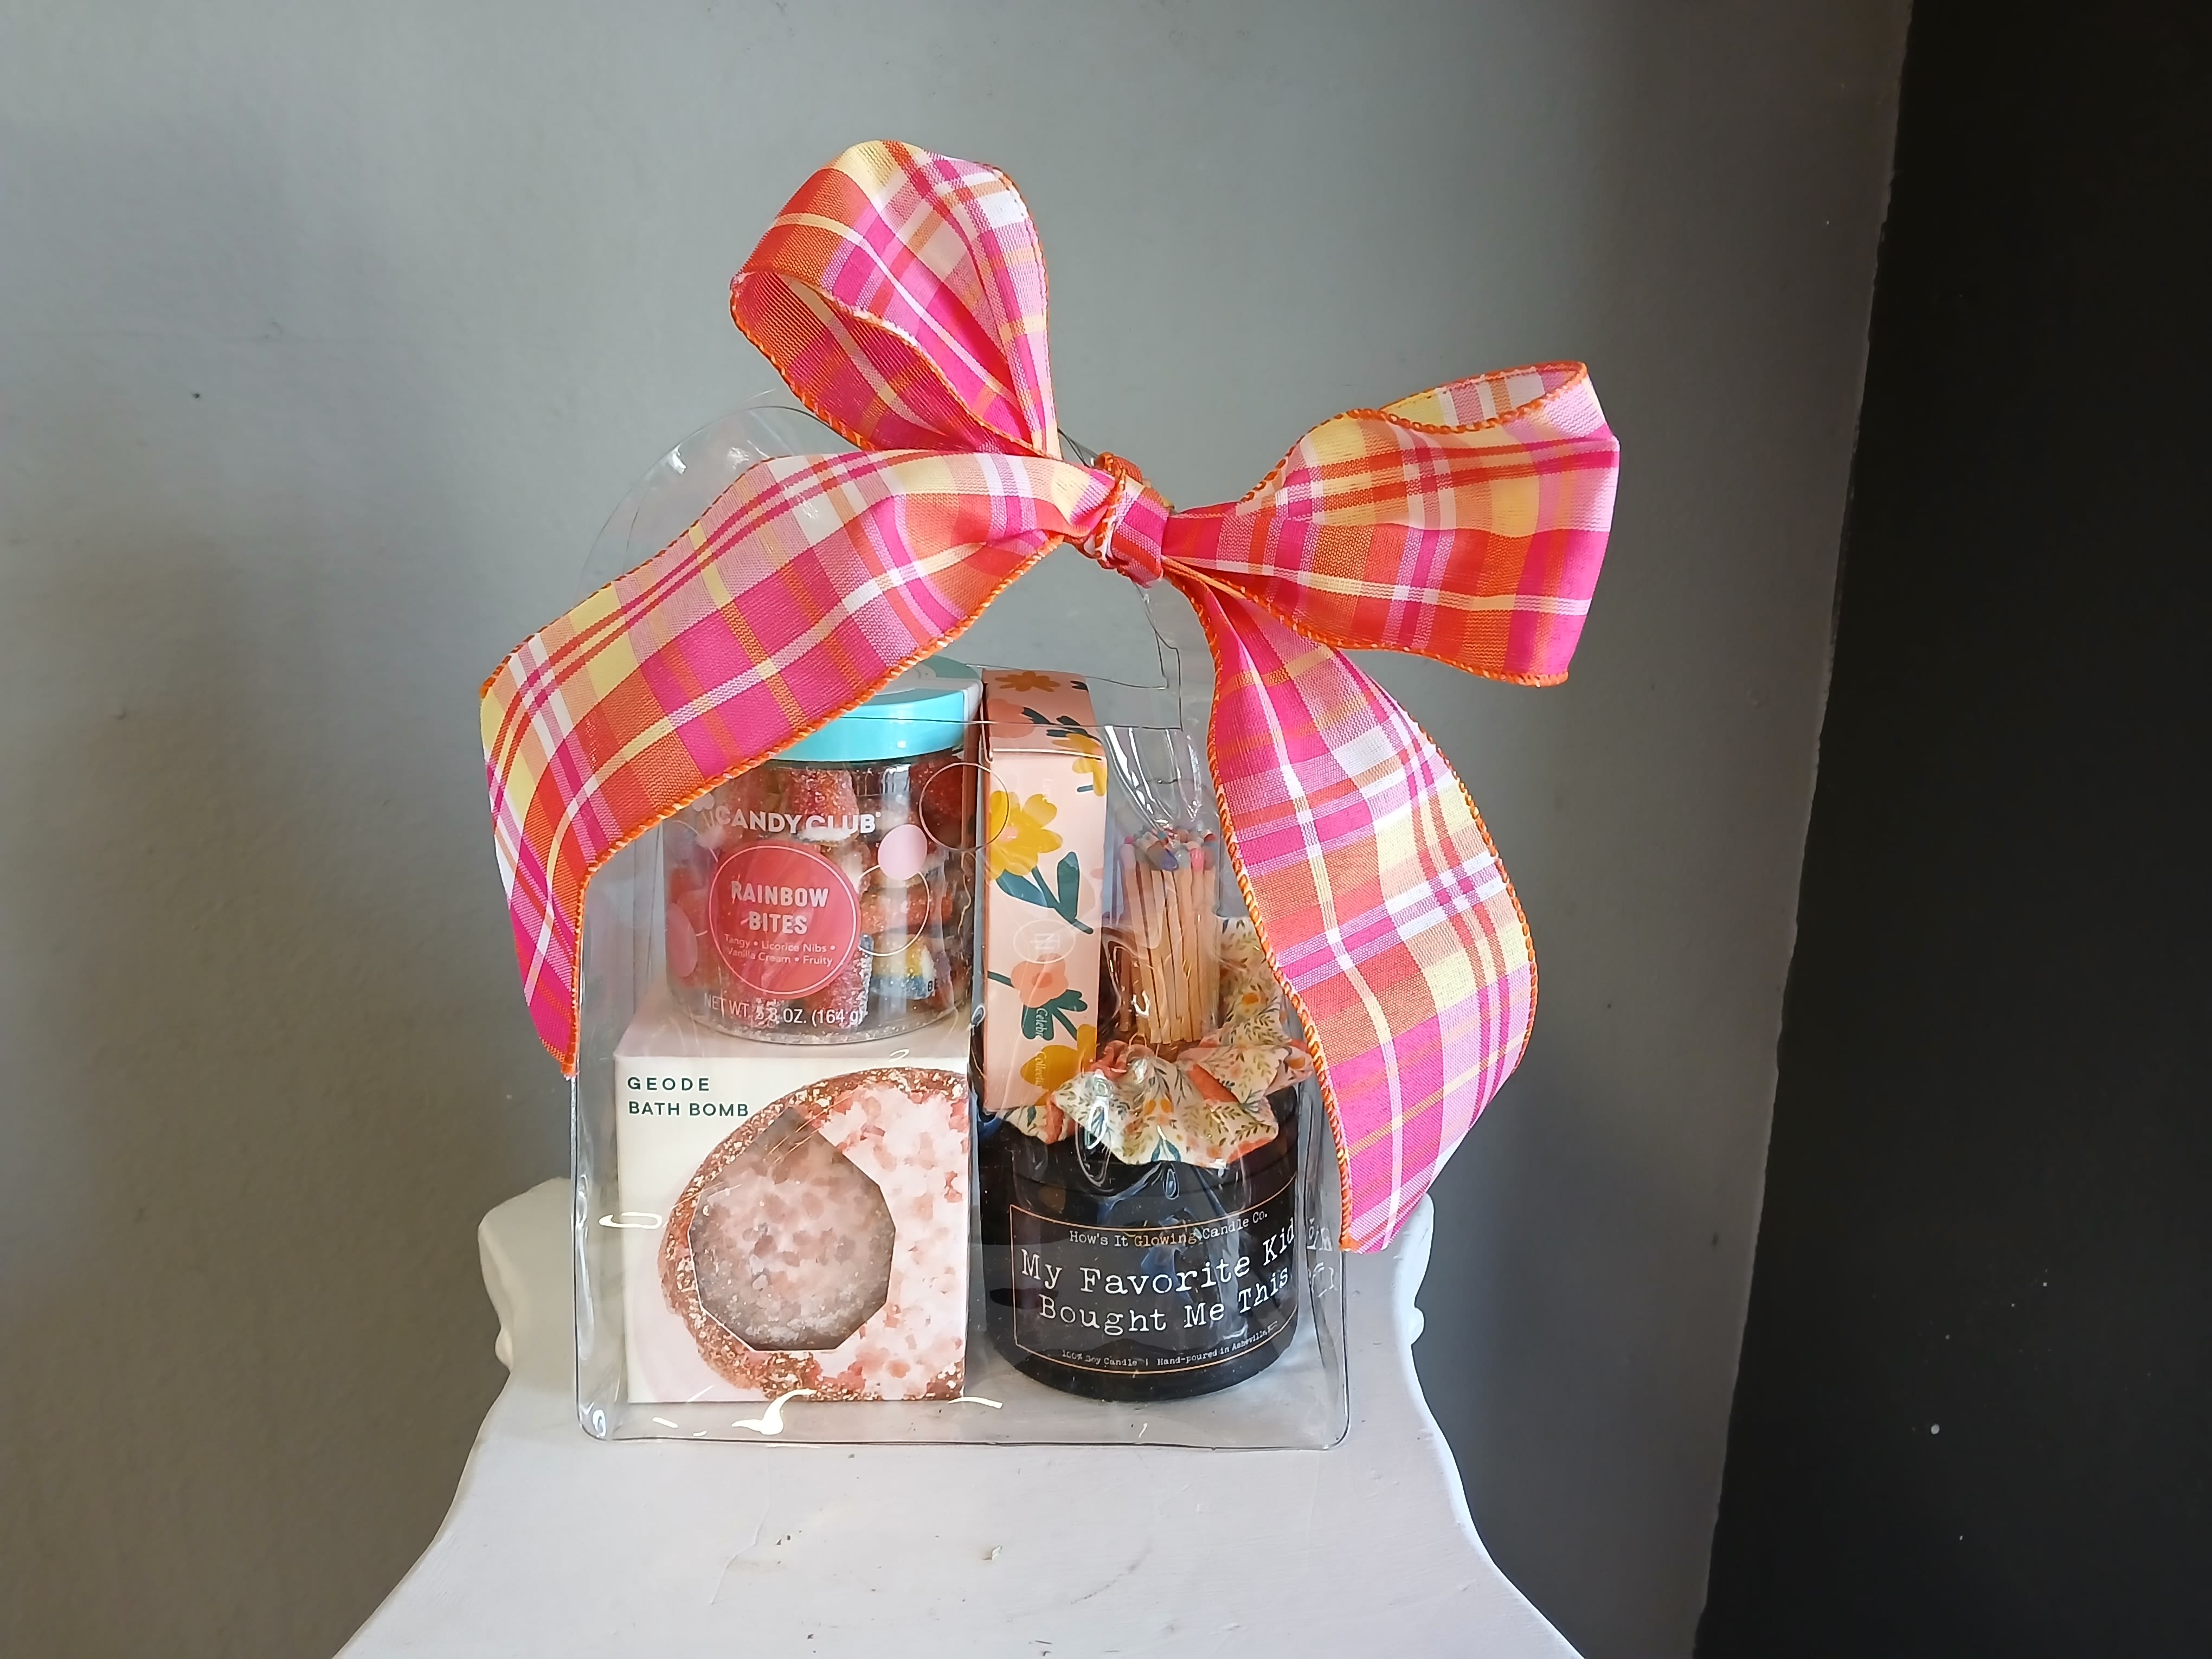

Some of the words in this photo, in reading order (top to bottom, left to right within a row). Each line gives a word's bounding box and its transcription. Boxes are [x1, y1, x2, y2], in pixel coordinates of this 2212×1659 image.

[715, 805, 802, 833] CANDY
[731, 881, 829, 908] RAINBOW
[749, 911, 808, 935] BITES
[724, 933, 751, 948] Tangy
[761, 941, 800, 951] Licorice
[803, 943, 827, 953] Nibs
[728, 947, 756, 960] Vanilla
[758, 952, 791, 963] Cream
[803, 955, 833, 968] Fruity
[704, 993, 726, 1013] NET
[783, 1008, 807, 1024] OZ.
[812, 1008, 845, 1027] (164
[627, 1077, 709, 1091] GEODE
[629, 1101, 679, 1116] BATH
[689, 1103, 748, 1117] BOMB
[1069, 1230, 1109, 1246] How's
[1114, 1234, 1129, 1247] It
[1134, 1232, 1198, 1247] Glowing
[1203, 1218, 1250, 1240] Candle
[1252, 1211, 1268, 1224] Co.
[1021, 1249, 1063, 1289] My
[1079, 1253, 1251, 1295] Favorite
[1262, 1217, 1295, 1266] Kid
[1039, 1294, 1167, 1336] Bought
[1184, 1301, 1225, 1329] Me
[1238, 1267, 1288, 1314] This
[1104, 1357, 1137, 1366] Candle
[1157, 1348, 1217, 1366] Hand-poured
[1220, 1346, 1230, 1355] in
